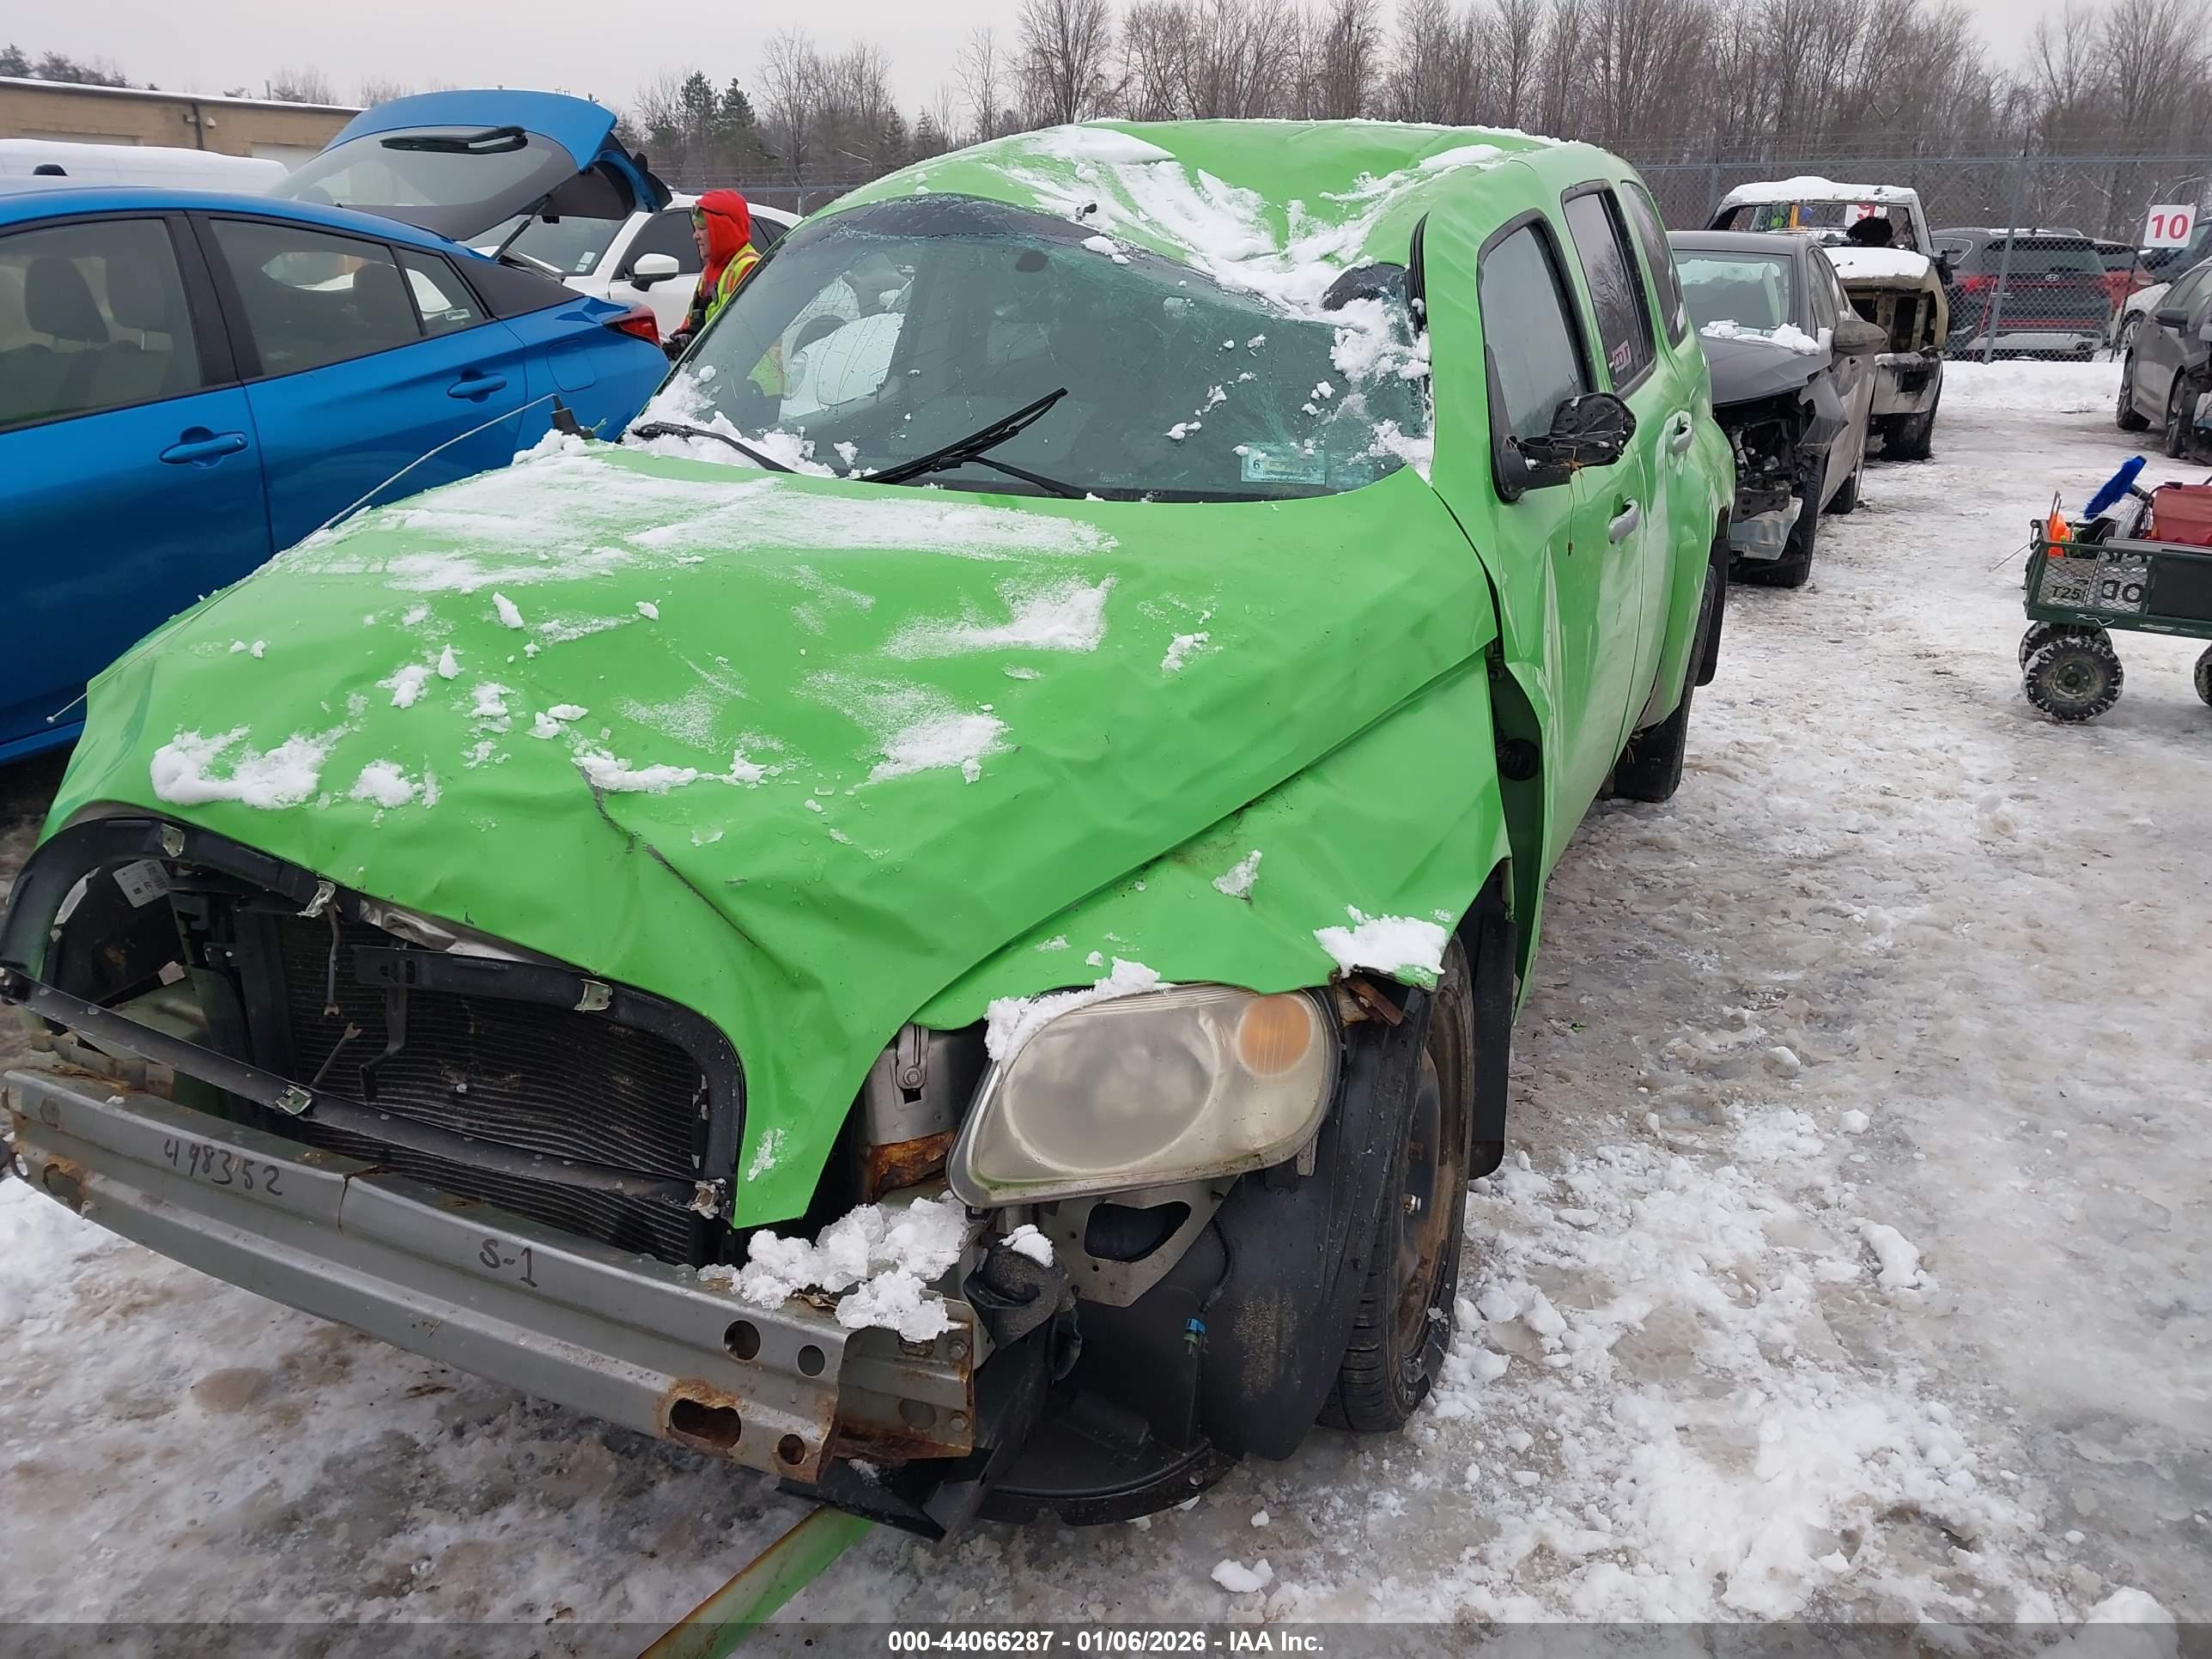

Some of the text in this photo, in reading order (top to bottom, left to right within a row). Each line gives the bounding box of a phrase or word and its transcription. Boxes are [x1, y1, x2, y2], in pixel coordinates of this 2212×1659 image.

[2152, 214, 2189, 240] 10
[1253, 459, 1261, 470] 6
[164, 1139, 283, 1195] 498352
[479, 1239, 538, 1287] S-1
